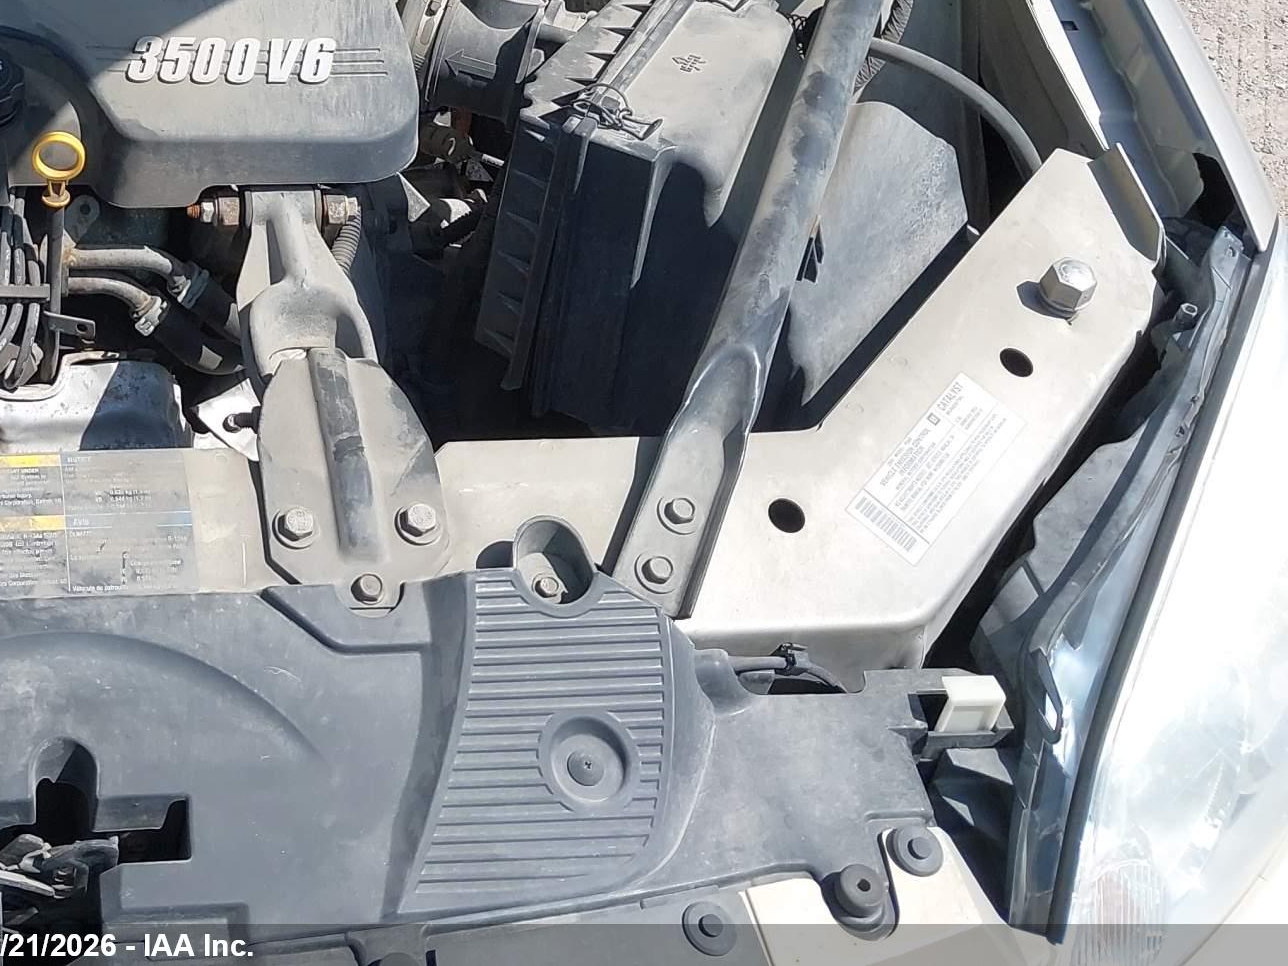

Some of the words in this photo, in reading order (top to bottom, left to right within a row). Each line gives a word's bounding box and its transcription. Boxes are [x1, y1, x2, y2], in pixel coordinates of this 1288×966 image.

[125, 35, 261, 84] 3500
[265, 37, 337, 84] V6
[937, 381, 963, 410] CATALYST
